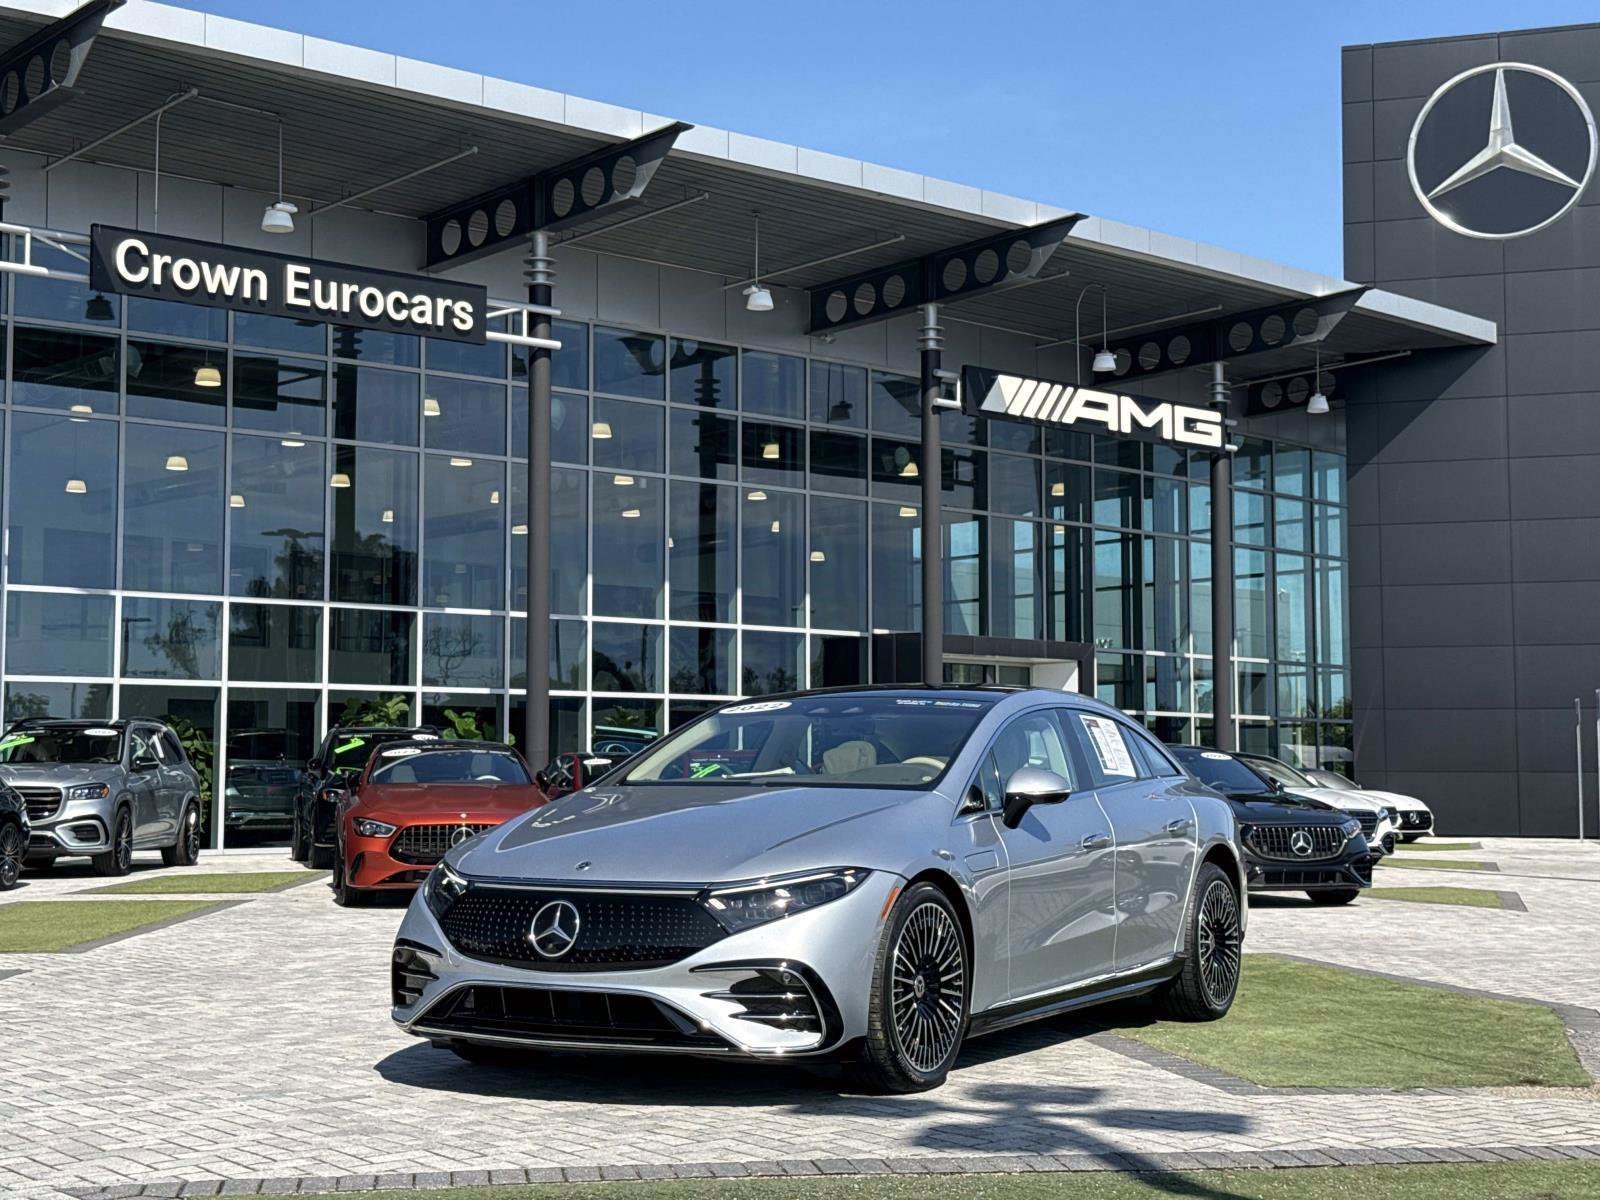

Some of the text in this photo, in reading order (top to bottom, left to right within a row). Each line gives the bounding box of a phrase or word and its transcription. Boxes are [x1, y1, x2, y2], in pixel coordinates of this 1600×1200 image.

[115, 238, 474, 331] Crown Eurocars
[1061, 388, 1222, 448] AMG
